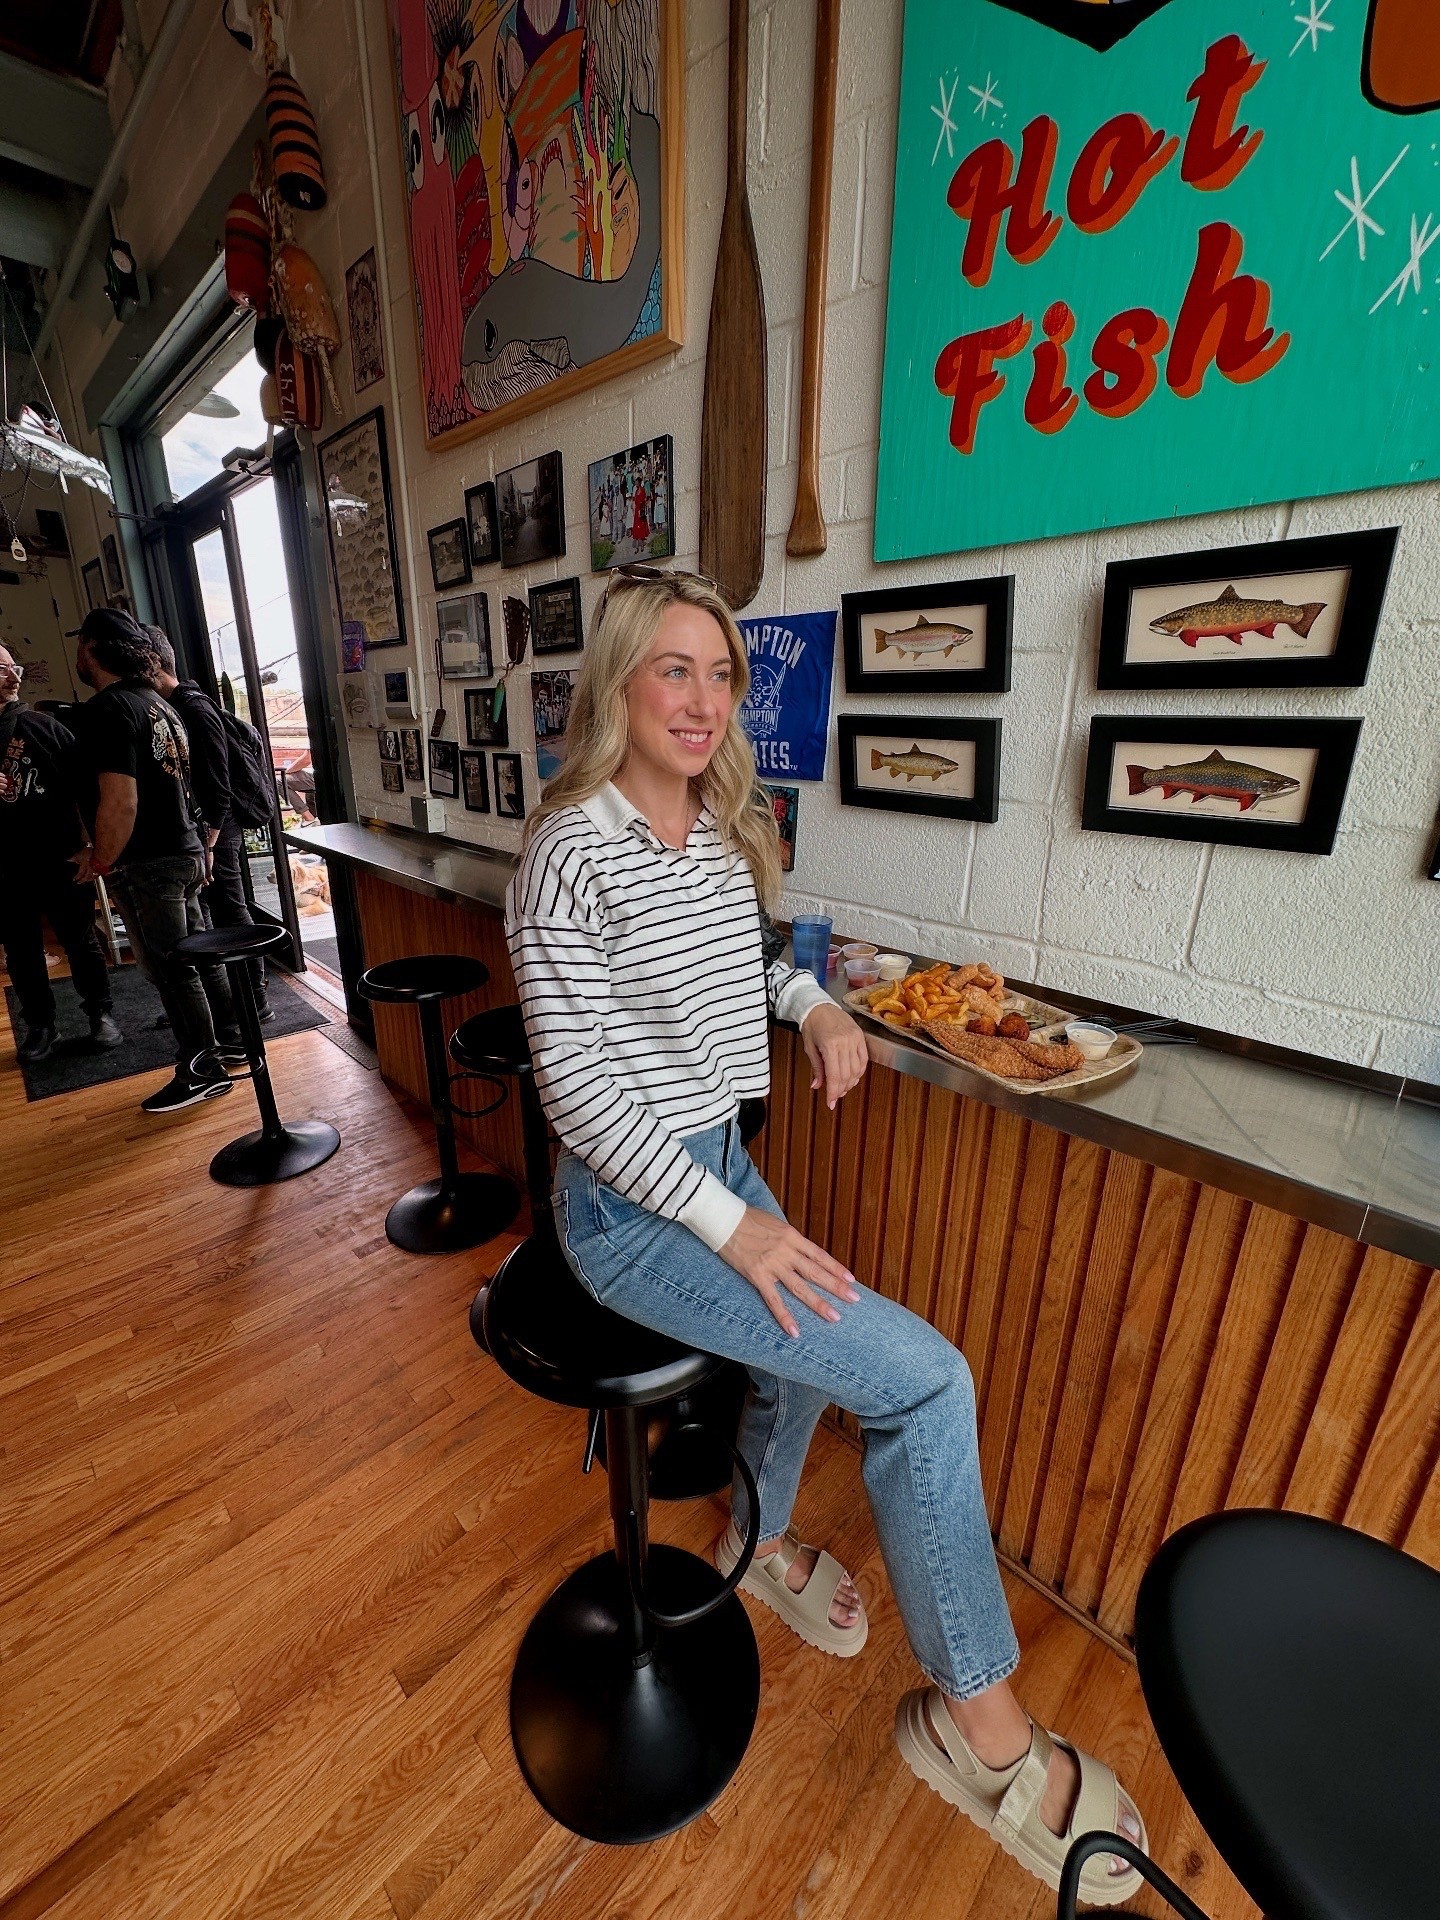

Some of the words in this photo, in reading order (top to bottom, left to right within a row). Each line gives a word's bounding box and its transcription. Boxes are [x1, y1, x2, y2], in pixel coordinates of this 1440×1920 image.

[947, 34, 1269, 287] Hot
[934, 222, 1290, 454] Fish
[745, 624, 807, 669] MPTON
[740, 709, 776, 726] HAMPTON
[752, 740, 790, 770] ATES
